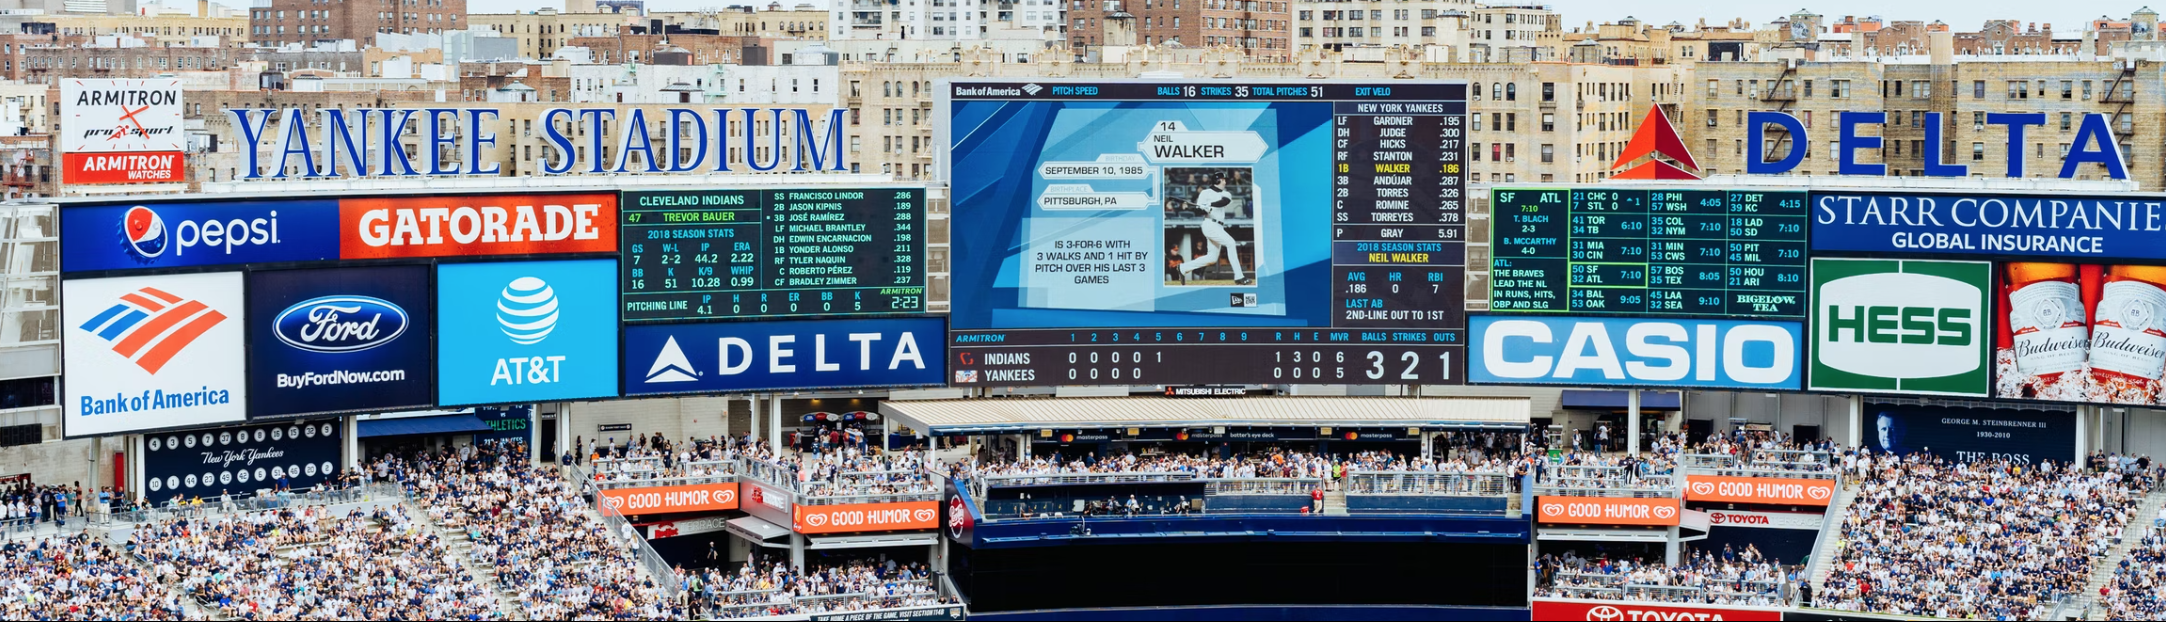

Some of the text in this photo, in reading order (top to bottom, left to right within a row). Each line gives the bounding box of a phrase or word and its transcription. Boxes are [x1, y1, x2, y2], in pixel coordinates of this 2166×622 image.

[956, 87, 1020, 95] Bank of America
[1053, 86, 1098, 95] PITCH SPEED
[1158, 86, 1195, 97] BALLS 16
[1201, 86, 1248, 97] STRIKES 35
[1253, 86, 1322, 97] TOTAL PITCHES 51
[1356, 88, 1371, 96] EXIT
[77, 91, 176, 106] ARMITRON
[1358, 104, 1443, 113] NEW YORK YANKEES
[1374, 116, 1412, 125] GARDNER
[1161, 122, 1175, 131] 14
[1379, 128, 1406, 137] JUDGE
[225, 109, 847, 178] YANKEE STADIUM
[1381, 140, 1406, 148] HICKS
[1747, 111, 2129, 179] DELTA
[1155, 145, 1224, 157] WALKER
[1373, 152, 1413, 160] STANTON
[84, 155, 172, 172] ARMITRON
[1375, 164, 1409, 173] WALKER
[128, 170, 171, 179] WATCHES
[1103, 167, 1116, 175] 10,
[1374, 174, 1412, 185] ANDÚJAR
[1376, 188, 1409, 197] TORRES
[1501, 193, 1515, 202] SF
[1540, 193, 1561, 202] ATL
[640, 195, 744, 205] CLEVELAND INDIANS
[1044, 197, 1102, 205] PITTSBURGH,
[1376, 200, 1409, 209] ROMINE
[629, 212, 734, 222] 47 TREVOR BAUER
[789, 212, 844, 221] JOSÉ RAMÍREZ
[1371, 213, 1413, 221] TORREYES
[1818, 195, 2166, 231] STARR COMPANIE
[359, 204, 599, 246] GATORADE
[177, 210, 277, 255] pepsi
[648, 229, 734, 239] 2018 SEASON STATS
[1381, 229, 1403, 237] GRAY
[1892, 232, 2103, 253] GLOBAL INSURANCE
[828, 265, 852, 274] PÉREZ
[628, 301, 687, 311] PITCHING LINE
[892, 296, 918, 308] 2:23
[1347, 299, 1383, 308] LAST AB
[1346, 310, 1444, 320] 2ND-LINE OUT TO 1ST
[299, 304, 380, 342] Ford
[1829, 305, 1971, 346] HESS
[956, 334, 1004, 342] ARMITRON
[1362, 333, 1455, 341] BALLS STRIKES OUTS
[2016, 336, 2087, 358] Budweiser
[2093, 330, 2166, 358] Budweiser
[719, 332, 925, 375] DELTA
[1483, 320, 1795, 384] CASIO
[985, 353, 1030, 365] INDIANS
[1366, 351, 1449, 379] 3 2 1
[490, 356, 566, 386] AT&T
[985, 369, 1035, 381] YANKEES
[277, 368, 405, 388] BuyFordNow.com
[81, 386, 229, 416] Bank of America
[201, 447, 283, 468] New York Yankees
[1719, 482, 1803, 499] GOOD HUMOR
[628, 490, 709, 509] GOOD HUMOR
[1568, 503, 1650, 518] GOOD HUMOR
[831, 509, 910, 526] GOOD HUMOR
[1727, 515, 1768, 524] TOYOTA
[680, 518, 725, 532] TERRACE
